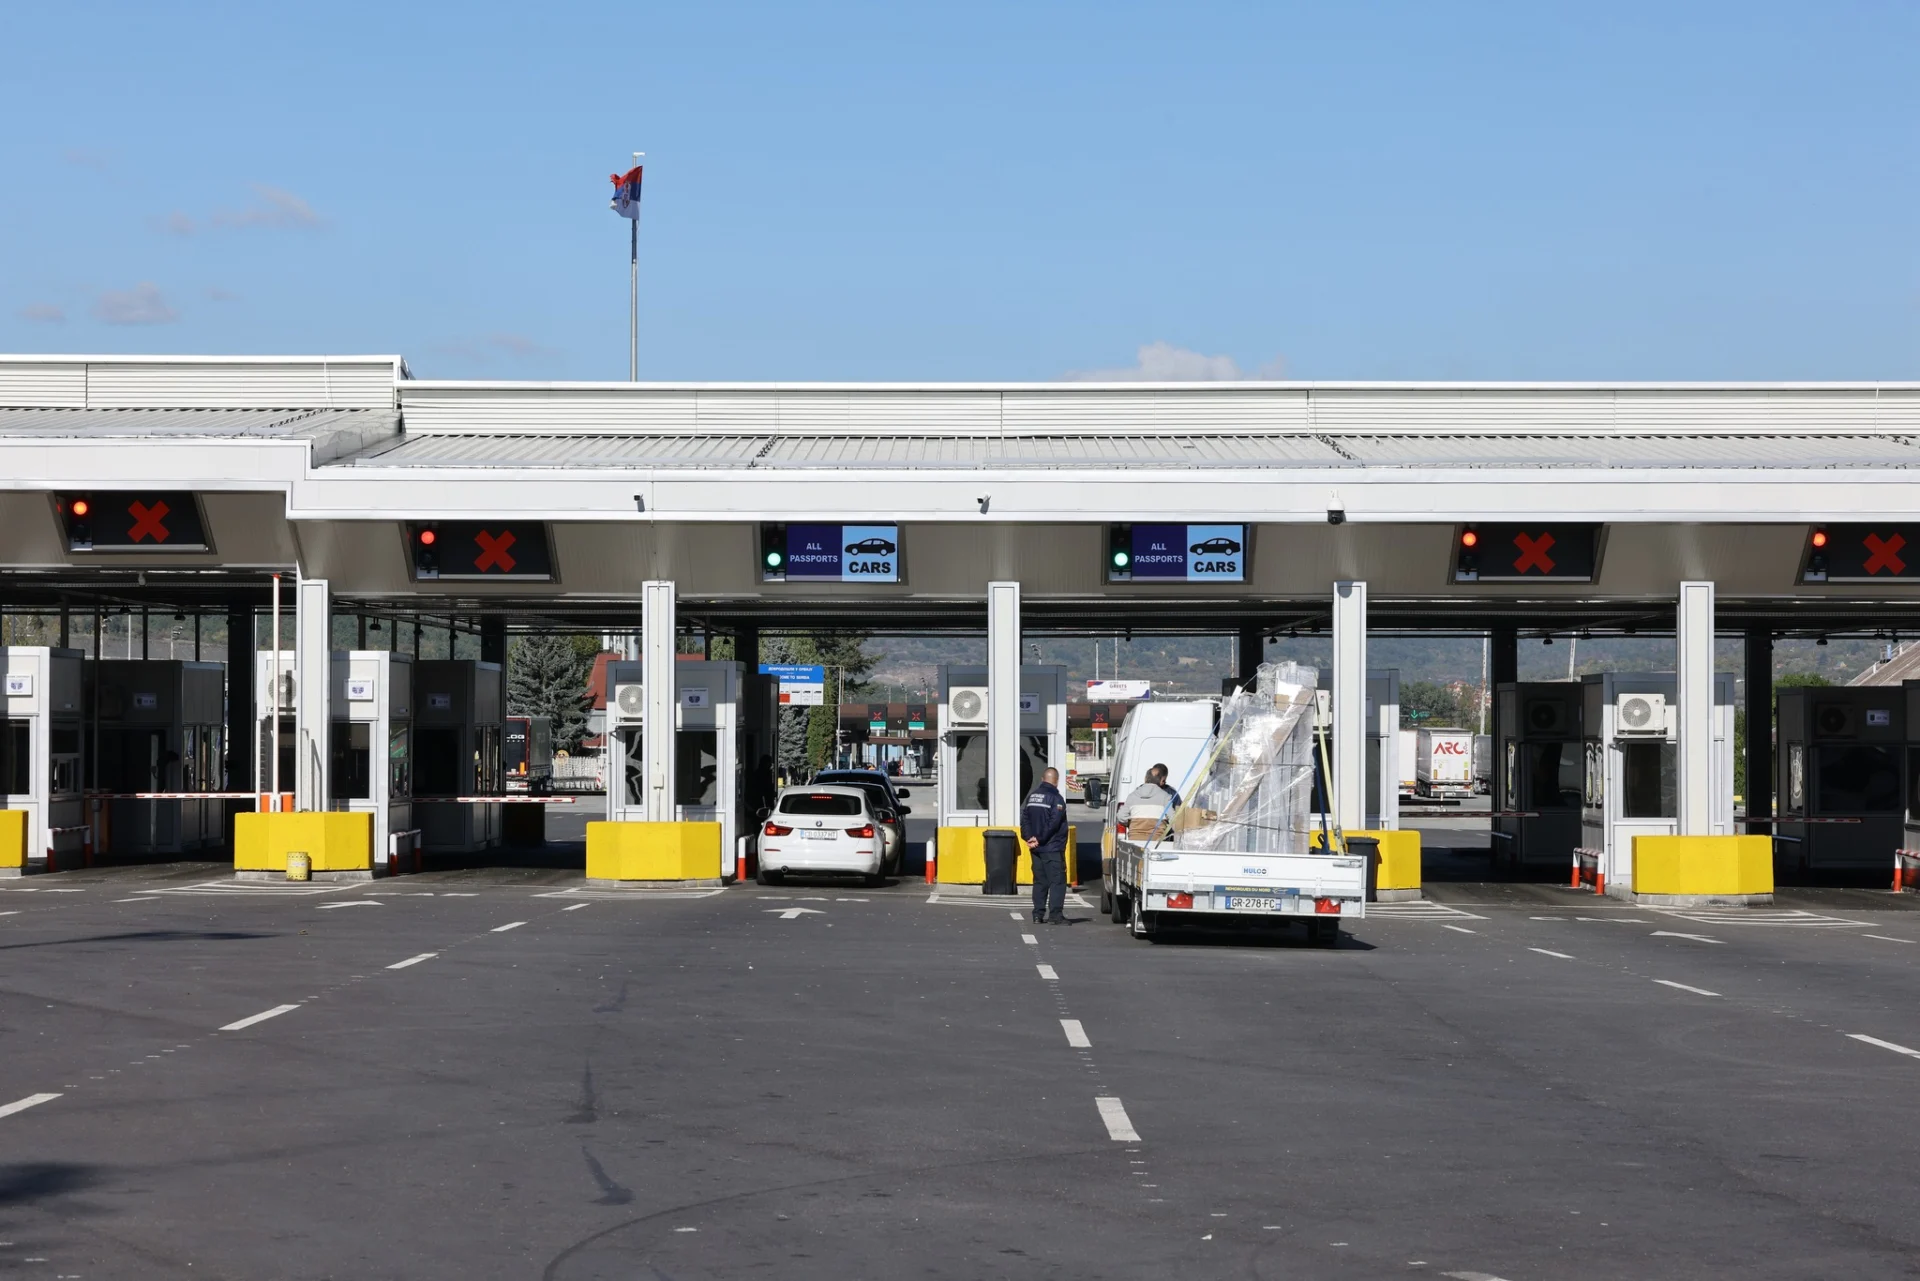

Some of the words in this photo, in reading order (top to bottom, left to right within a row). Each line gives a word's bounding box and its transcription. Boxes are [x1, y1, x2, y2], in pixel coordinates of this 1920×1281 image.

[849, 562, 891, 573] CARS
[1194, 562, 1236, 572] CARS
[1434, 742, 1464, 754] ARC
